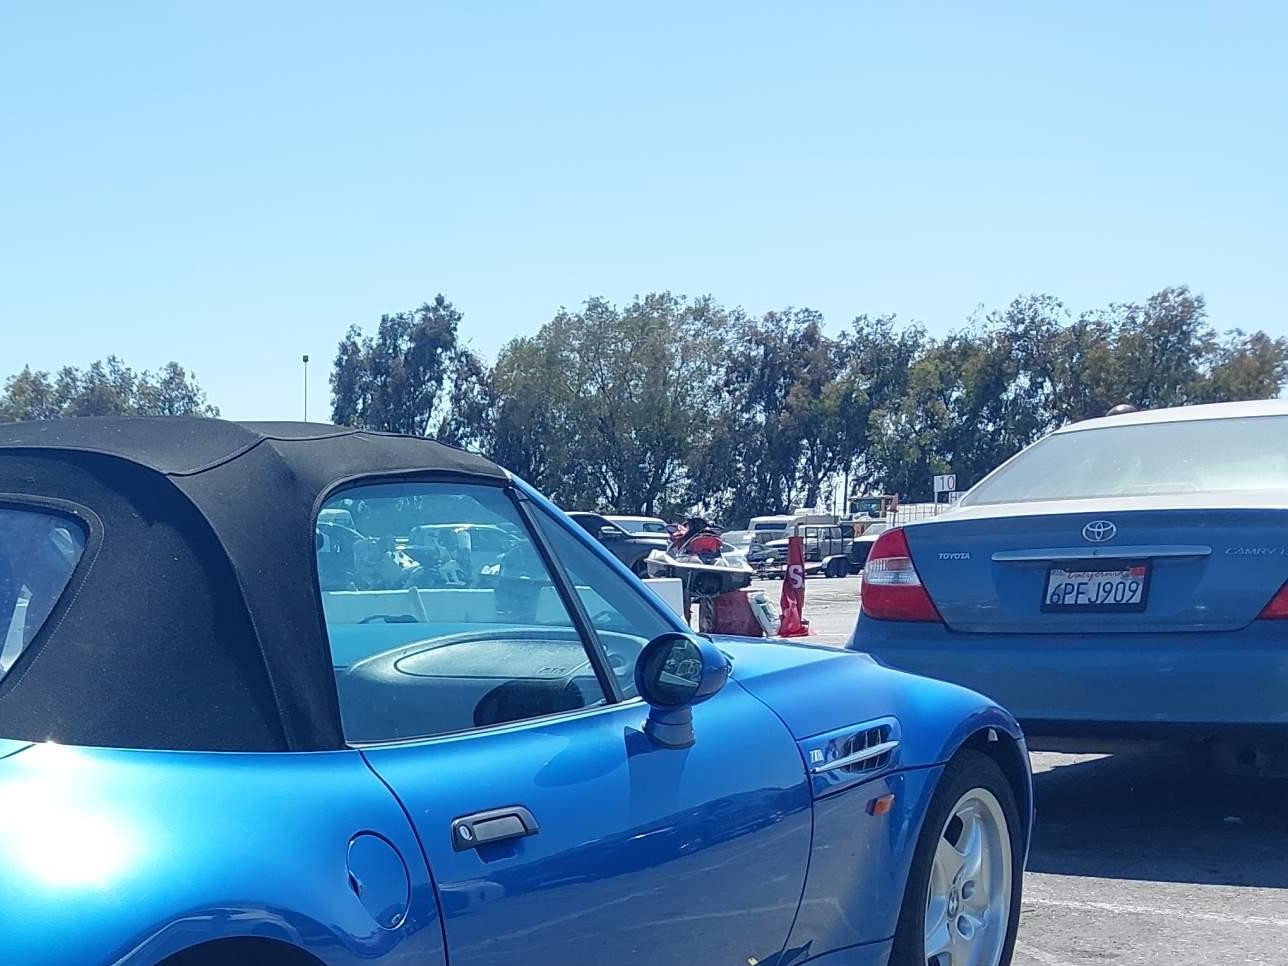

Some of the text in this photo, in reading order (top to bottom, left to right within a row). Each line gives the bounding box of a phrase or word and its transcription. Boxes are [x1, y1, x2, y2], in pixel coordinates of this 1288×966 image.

[939, 475, 955, 491] 10
[938, 552, 970, 560] TOYOTA
[788, 564, 803, 589] S
[1049, 581, 1140, 605] 6PFJ909
